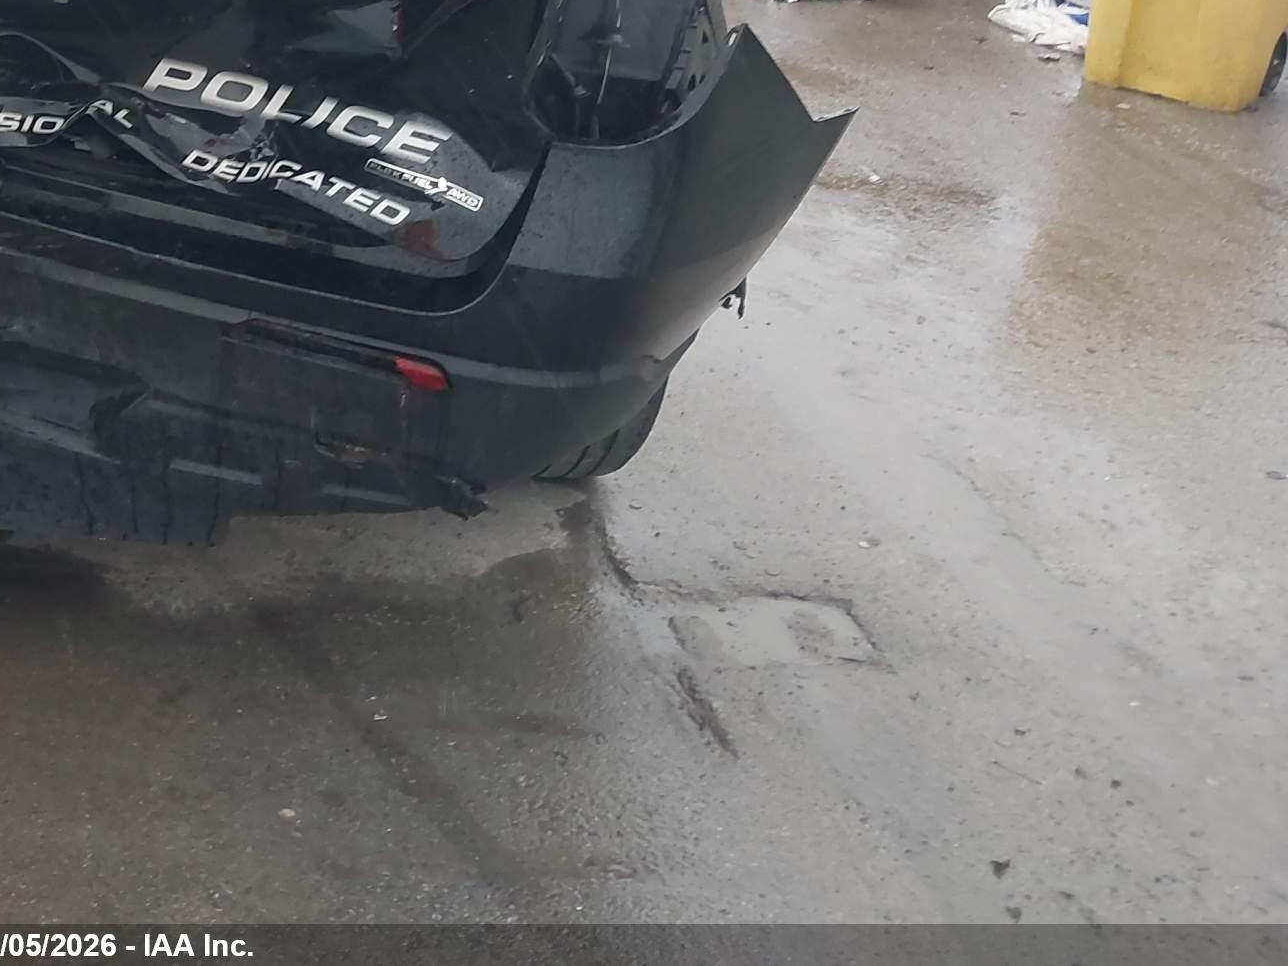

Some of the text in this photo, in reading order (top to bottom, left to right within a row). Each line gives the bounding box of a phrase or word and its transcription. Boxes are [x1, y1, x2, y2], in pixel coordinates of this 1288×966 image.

[144, 57, 454, 165] POLICE
[182, 149, 412, 226] DEDICATED
[368, 162, 479, 208] FLEX FUEL AWD
